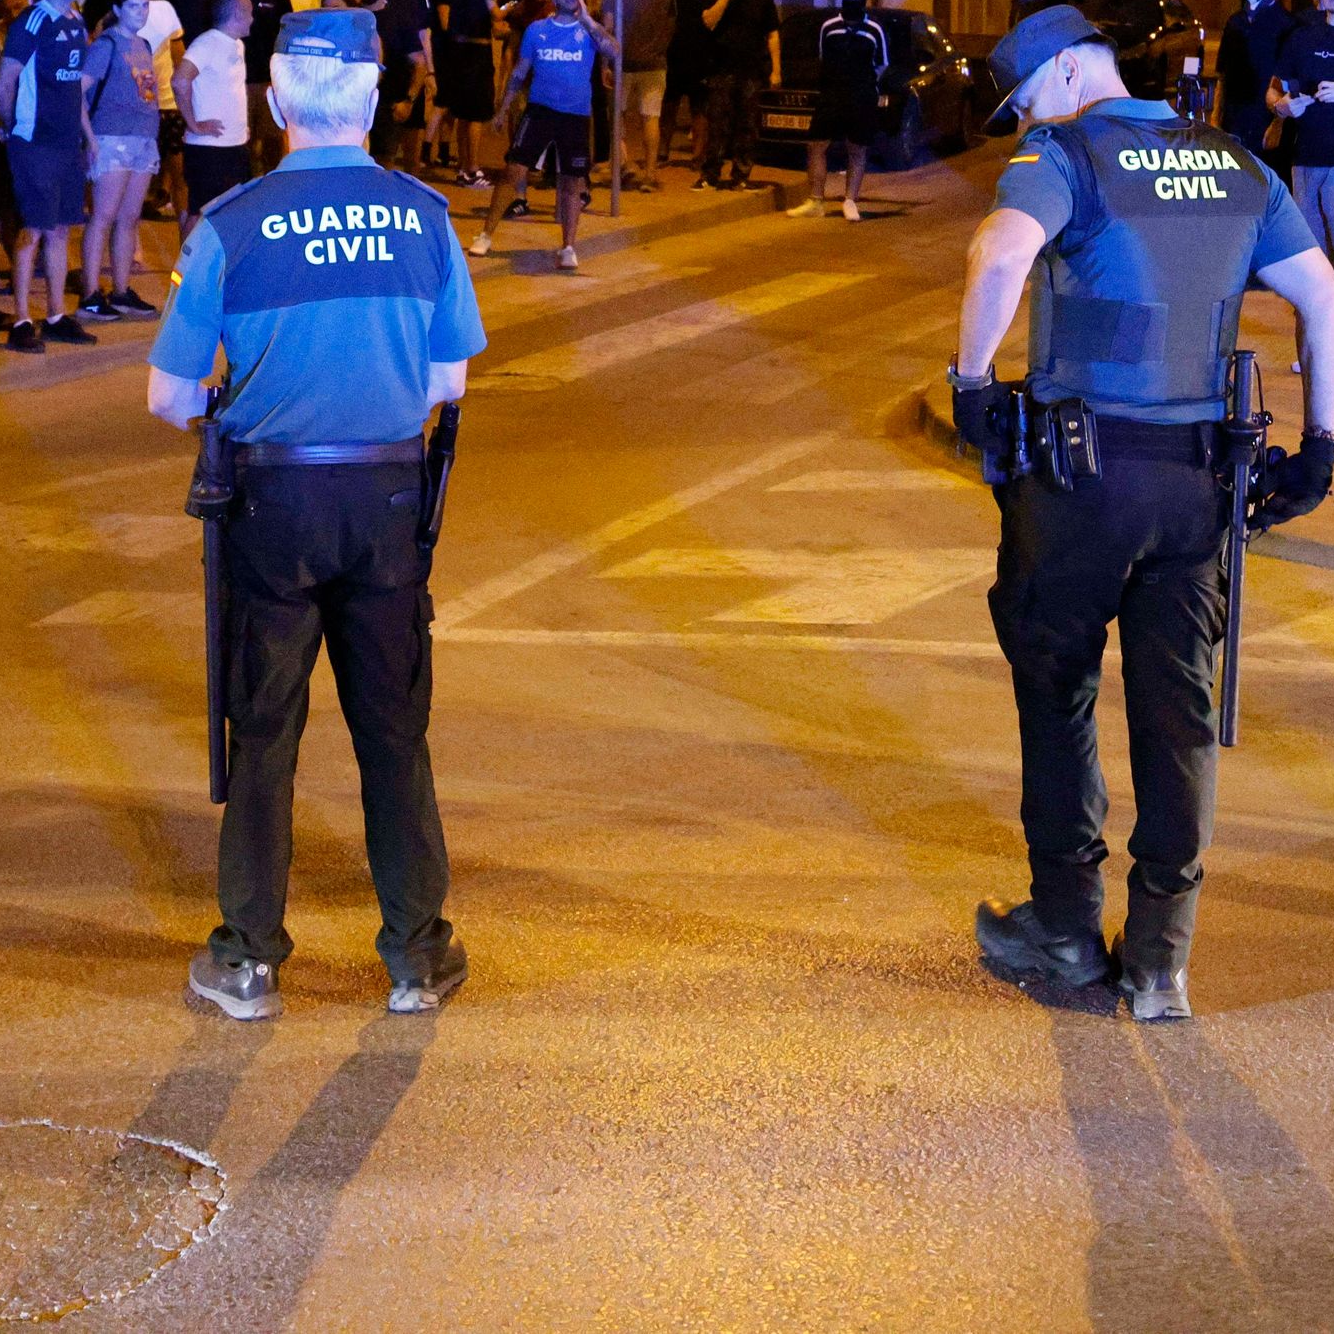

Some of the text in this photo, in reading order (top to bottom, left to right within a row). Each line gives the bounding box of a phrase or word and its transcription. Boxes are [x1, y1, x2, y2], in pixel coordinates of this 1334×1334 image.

[535, 48, 583, 62] 32Red
[1118, 149, 1241, 171] GUARDIA
[1154, 176, 1227, 200] CIVIL
[261, 205, 422, 240] GUARDIA
[304, 235, 394, 265] CIVIL
